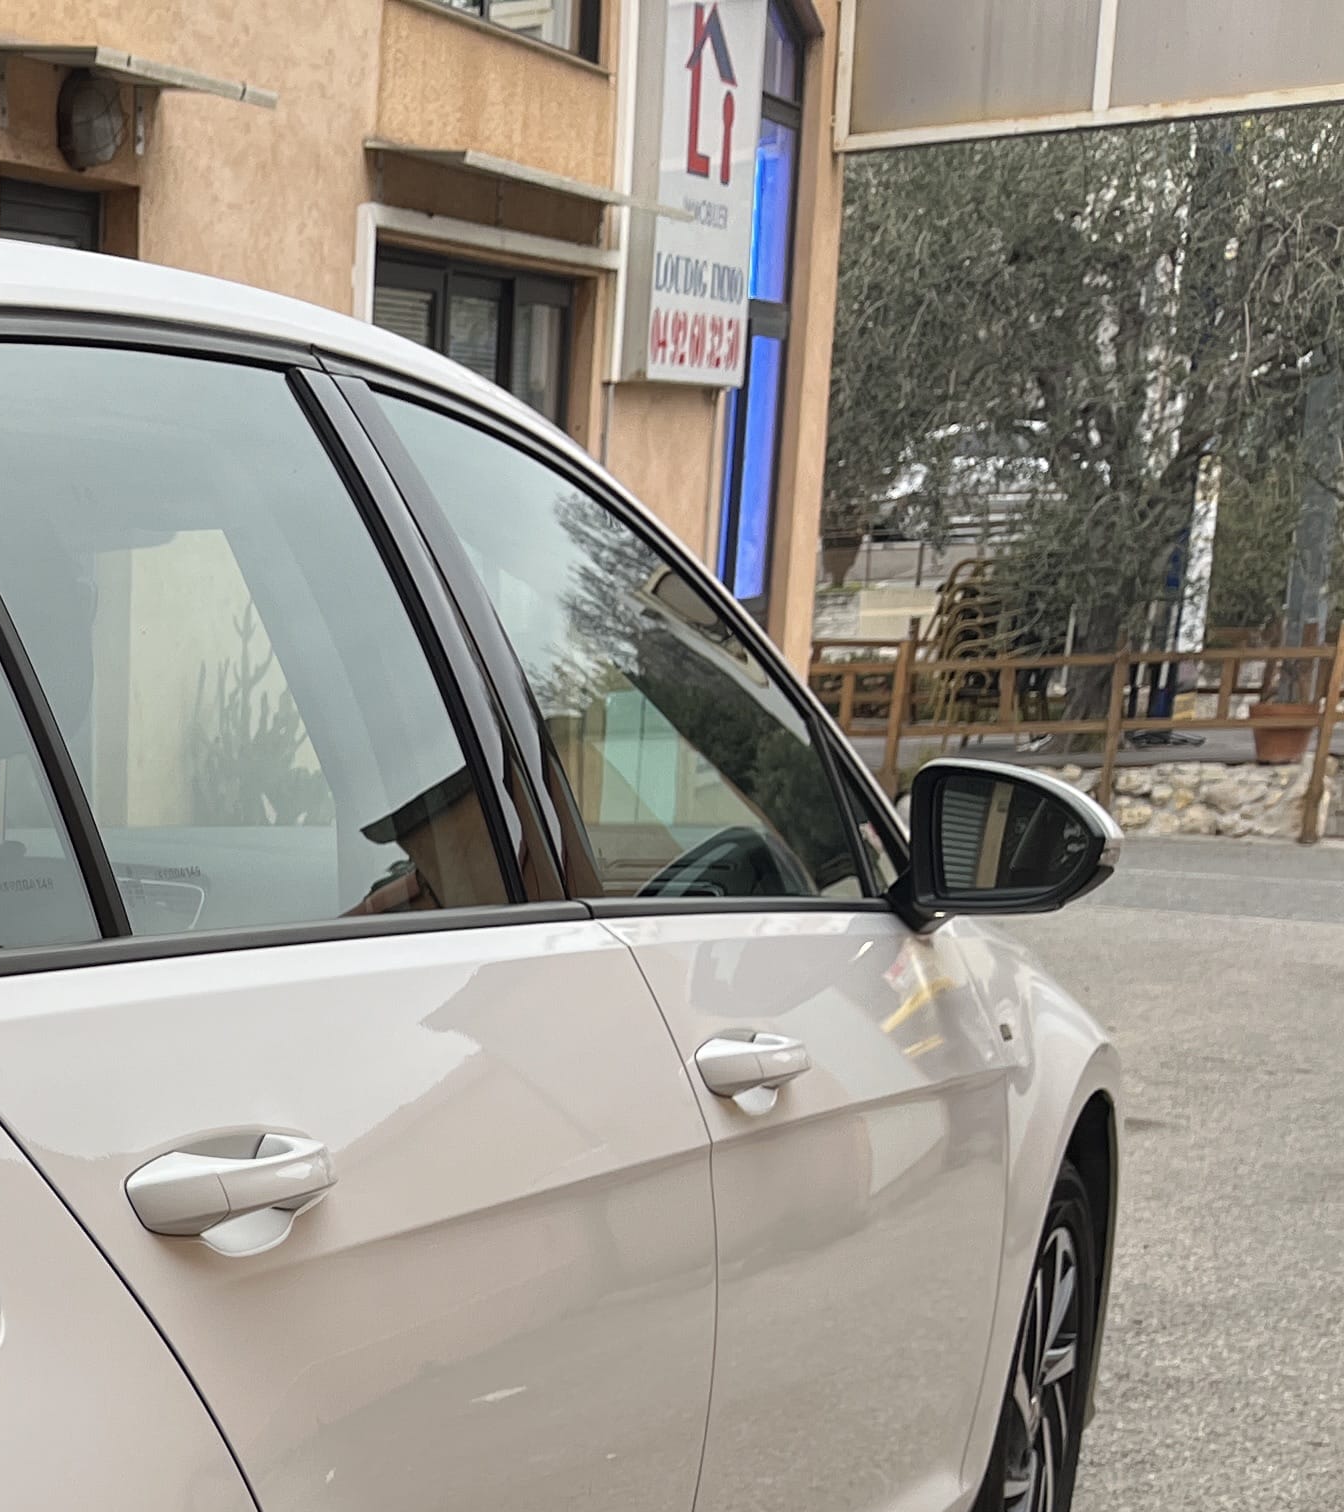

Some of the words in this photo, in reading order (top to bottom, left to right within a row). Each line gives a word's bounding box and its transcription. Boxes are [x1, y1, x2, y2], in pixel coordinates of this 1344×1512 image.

[650, 306, 668, 365] 04
[670, 310, 688, 367] 92
[689, 312, 706, 369] 60
[707, 315, 723, 369] 32
